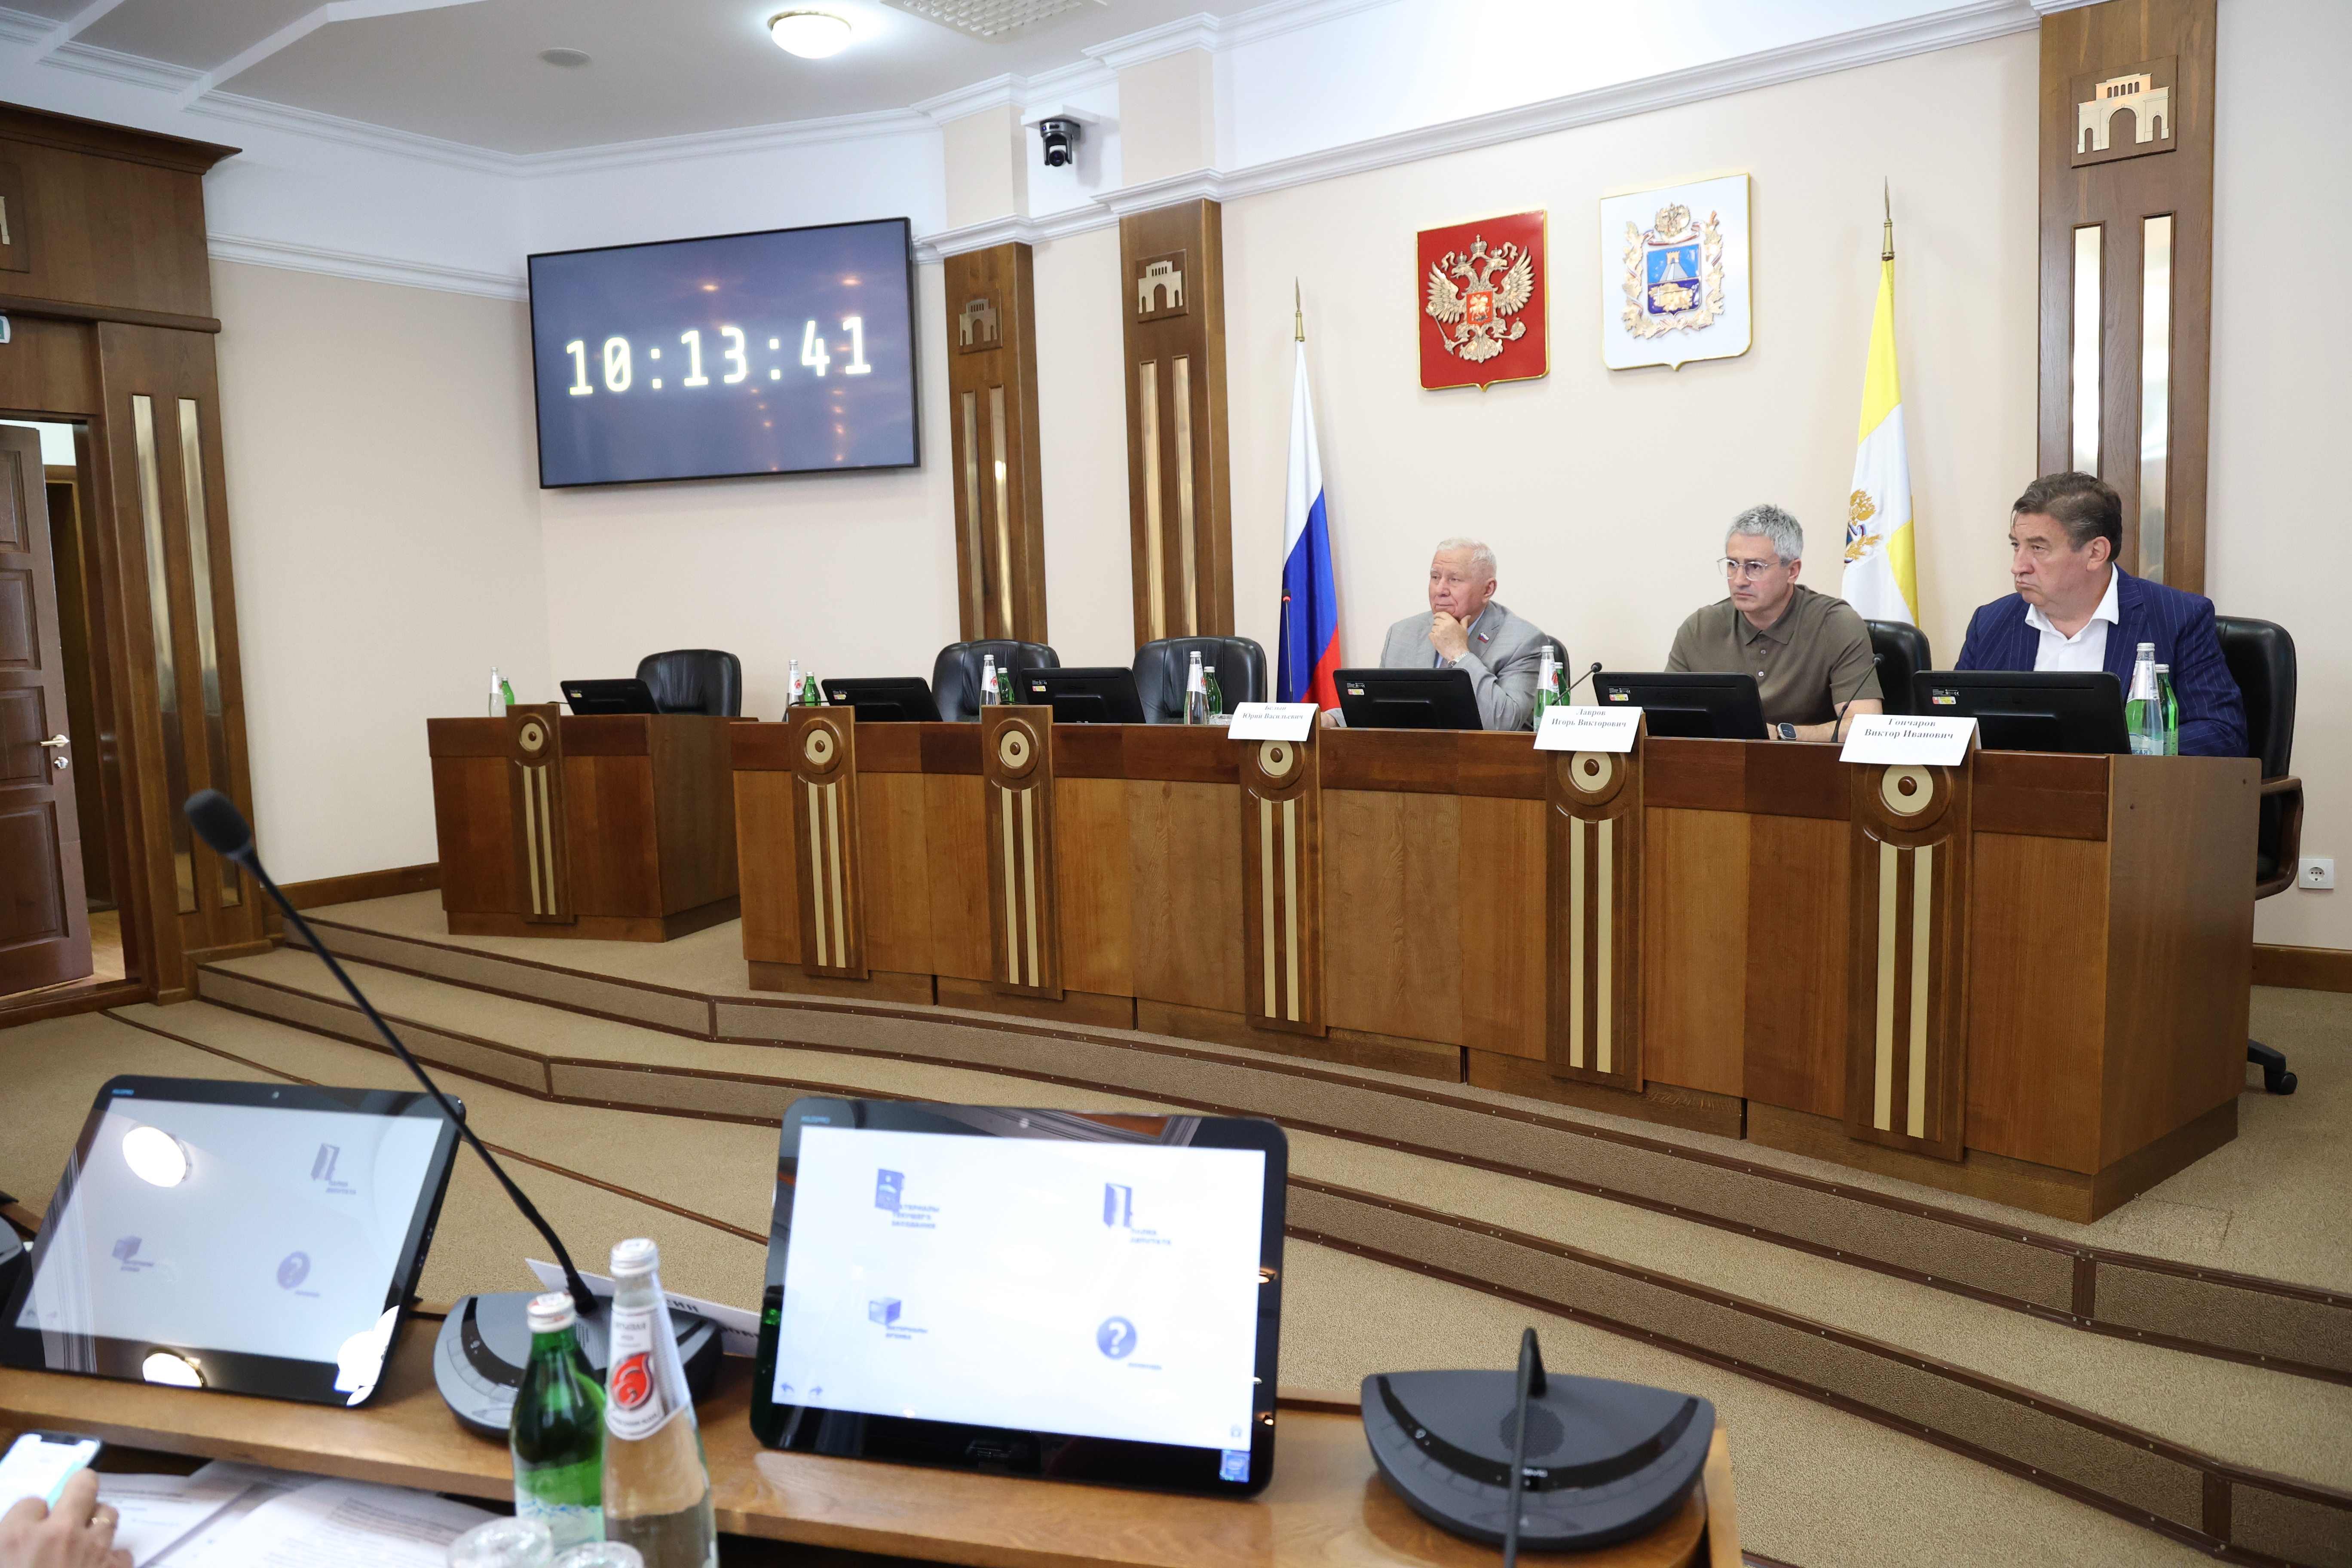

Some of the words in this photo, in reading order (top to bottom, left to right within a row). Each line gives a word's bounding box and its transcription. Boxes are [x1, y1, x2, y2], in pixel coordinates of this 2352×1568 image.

[566, 317, 871, 395] 10:13:41
[1576, 708, 1606, 717] Лавров
[1551, 718, 1575, 726] Игорь
[1577, 719, 1626, 728] Викторович
[1888, 718, 1936, 727] Гончаров
[1864, 729, 1901, 739] Виктор
[1902, 729, 1954, 739] Иванович
